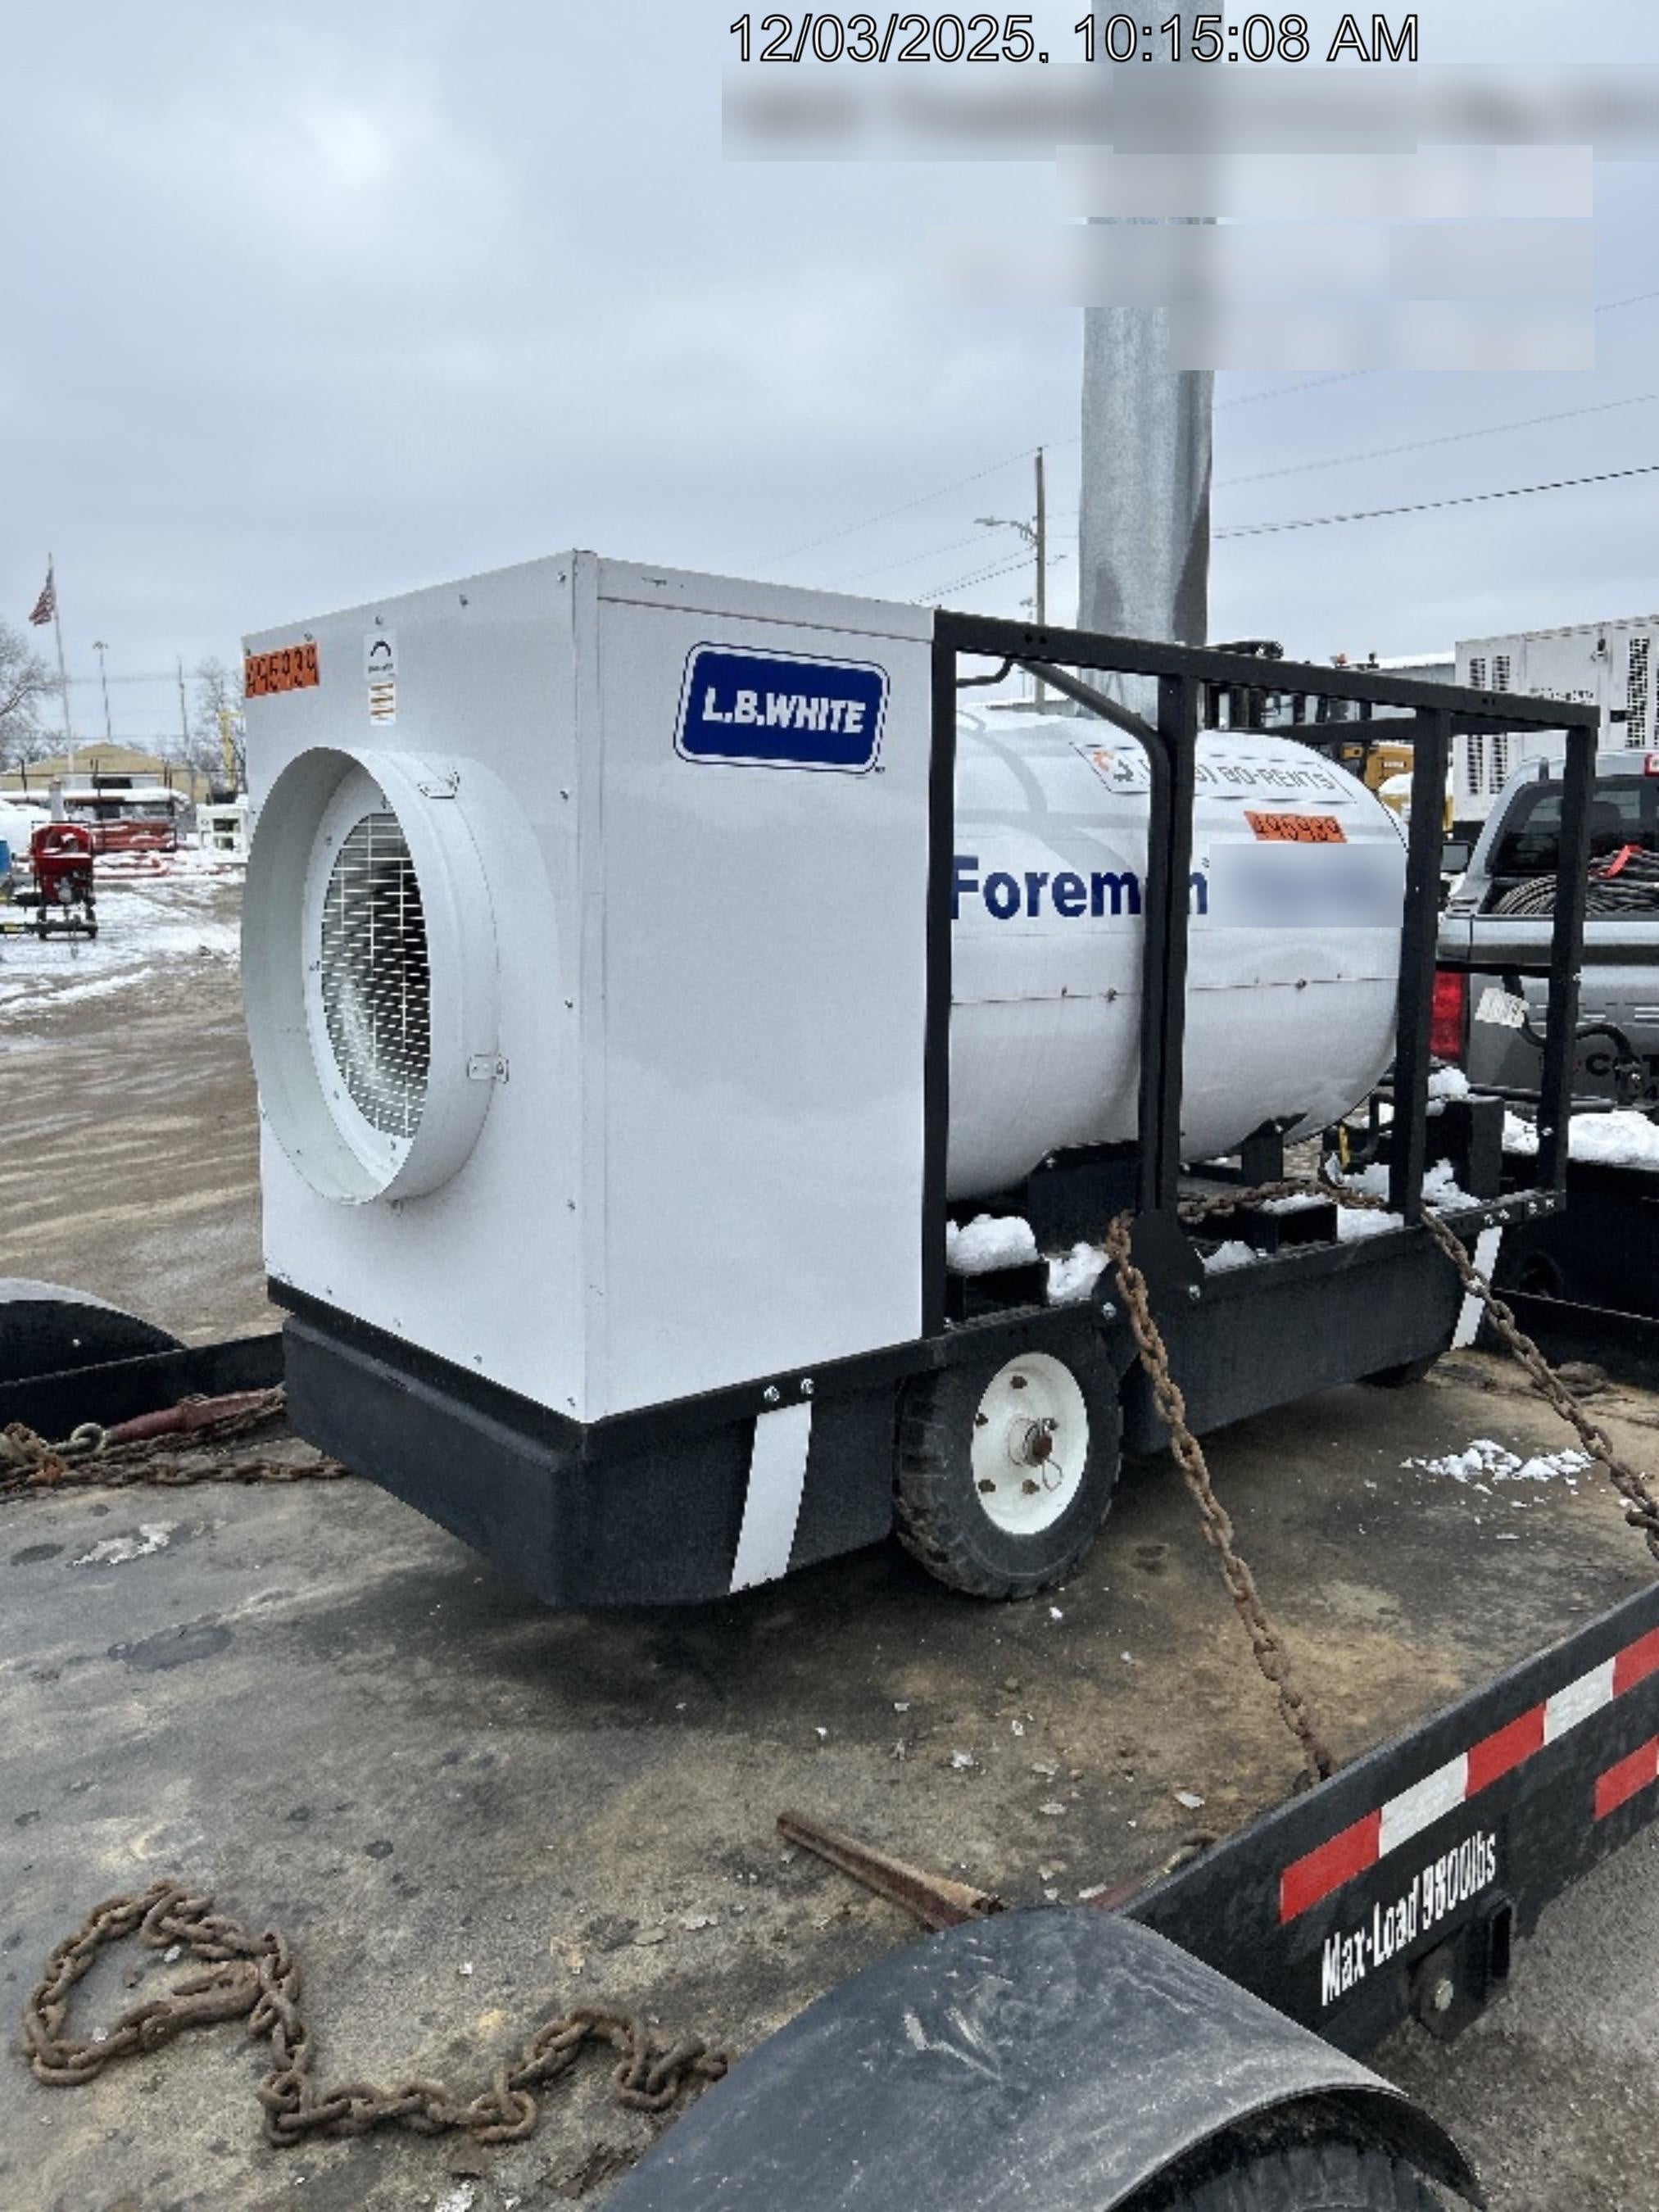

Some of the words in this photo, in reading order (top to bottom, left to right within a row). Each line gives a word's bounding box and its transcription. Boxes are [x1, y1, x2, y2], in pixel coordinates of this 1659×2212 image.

[702, 685, 866, 733] L.B.WHITE
[951, 855, 1208, 919] Foremn
[1321, 1875, 1419, 2006] Max-Load
[1422, 1830, 1496, 1930] 9800lbs
